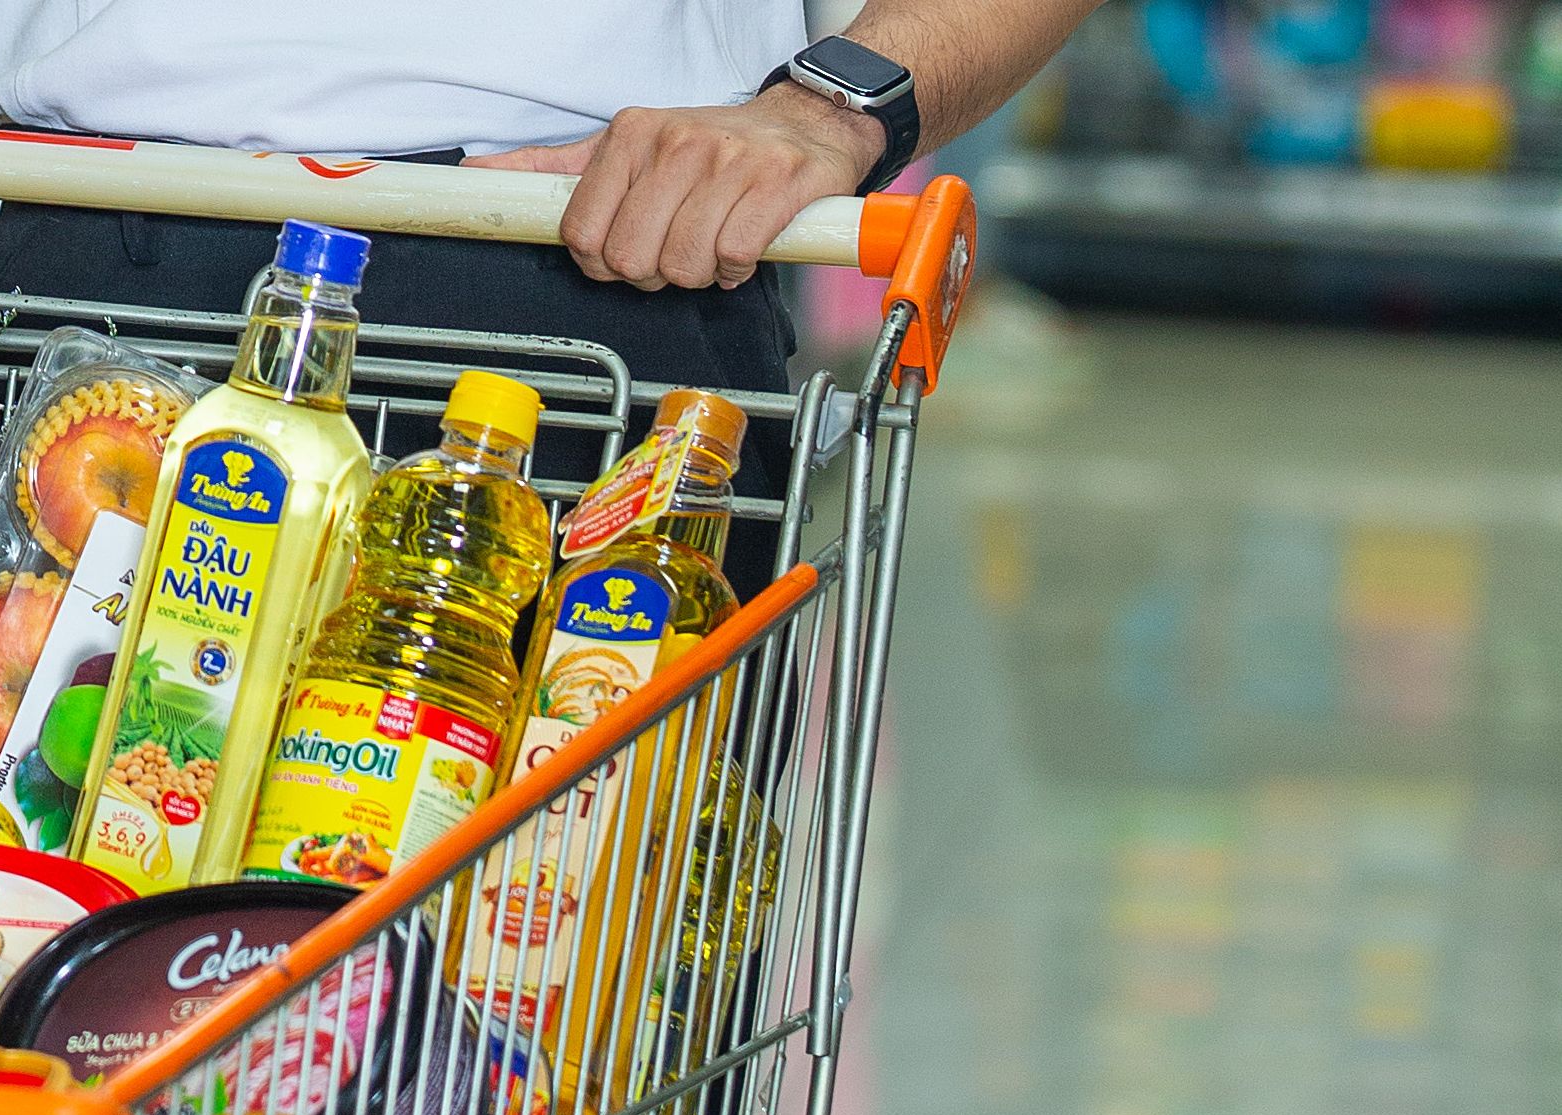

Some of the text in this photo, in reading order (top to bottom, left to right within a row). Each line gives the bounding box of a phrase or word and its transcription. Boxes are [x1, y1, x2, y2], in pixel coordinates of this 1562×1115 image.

[182, 535, 251, 577] ĐẬU
[160, 566, 252, 618] NÀNH
[102, 1032, 144, 1052] CHUA
